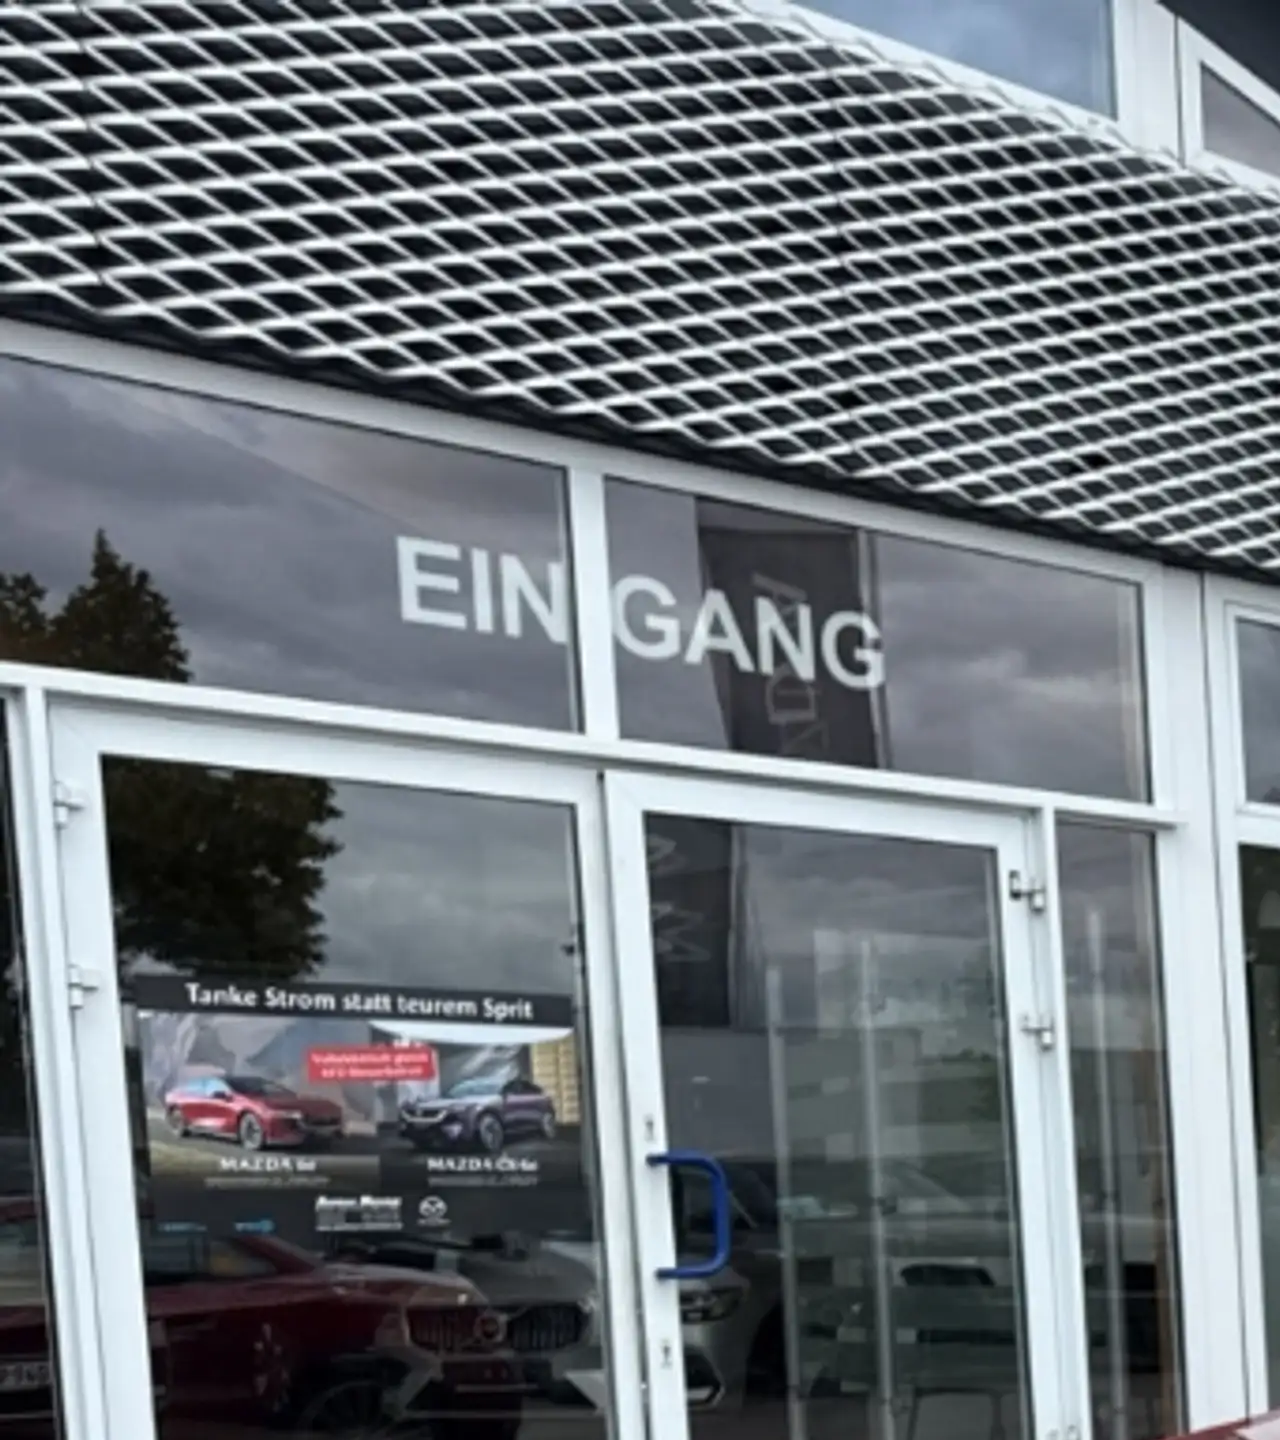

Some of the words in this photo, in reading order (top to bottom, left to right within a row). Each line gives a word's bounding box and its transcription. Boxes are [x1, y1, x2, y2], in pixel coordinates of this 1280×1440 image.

[396, 535, 887, 690] EINGANG
[184, 981, 258, 1007] Tanke
[264, 986, 336, 1010] Strom
[343, 992, 392, 1013] statt
[397, 993, 478, 1018] teurem
[482, 997, 534, 1022] Sprit
